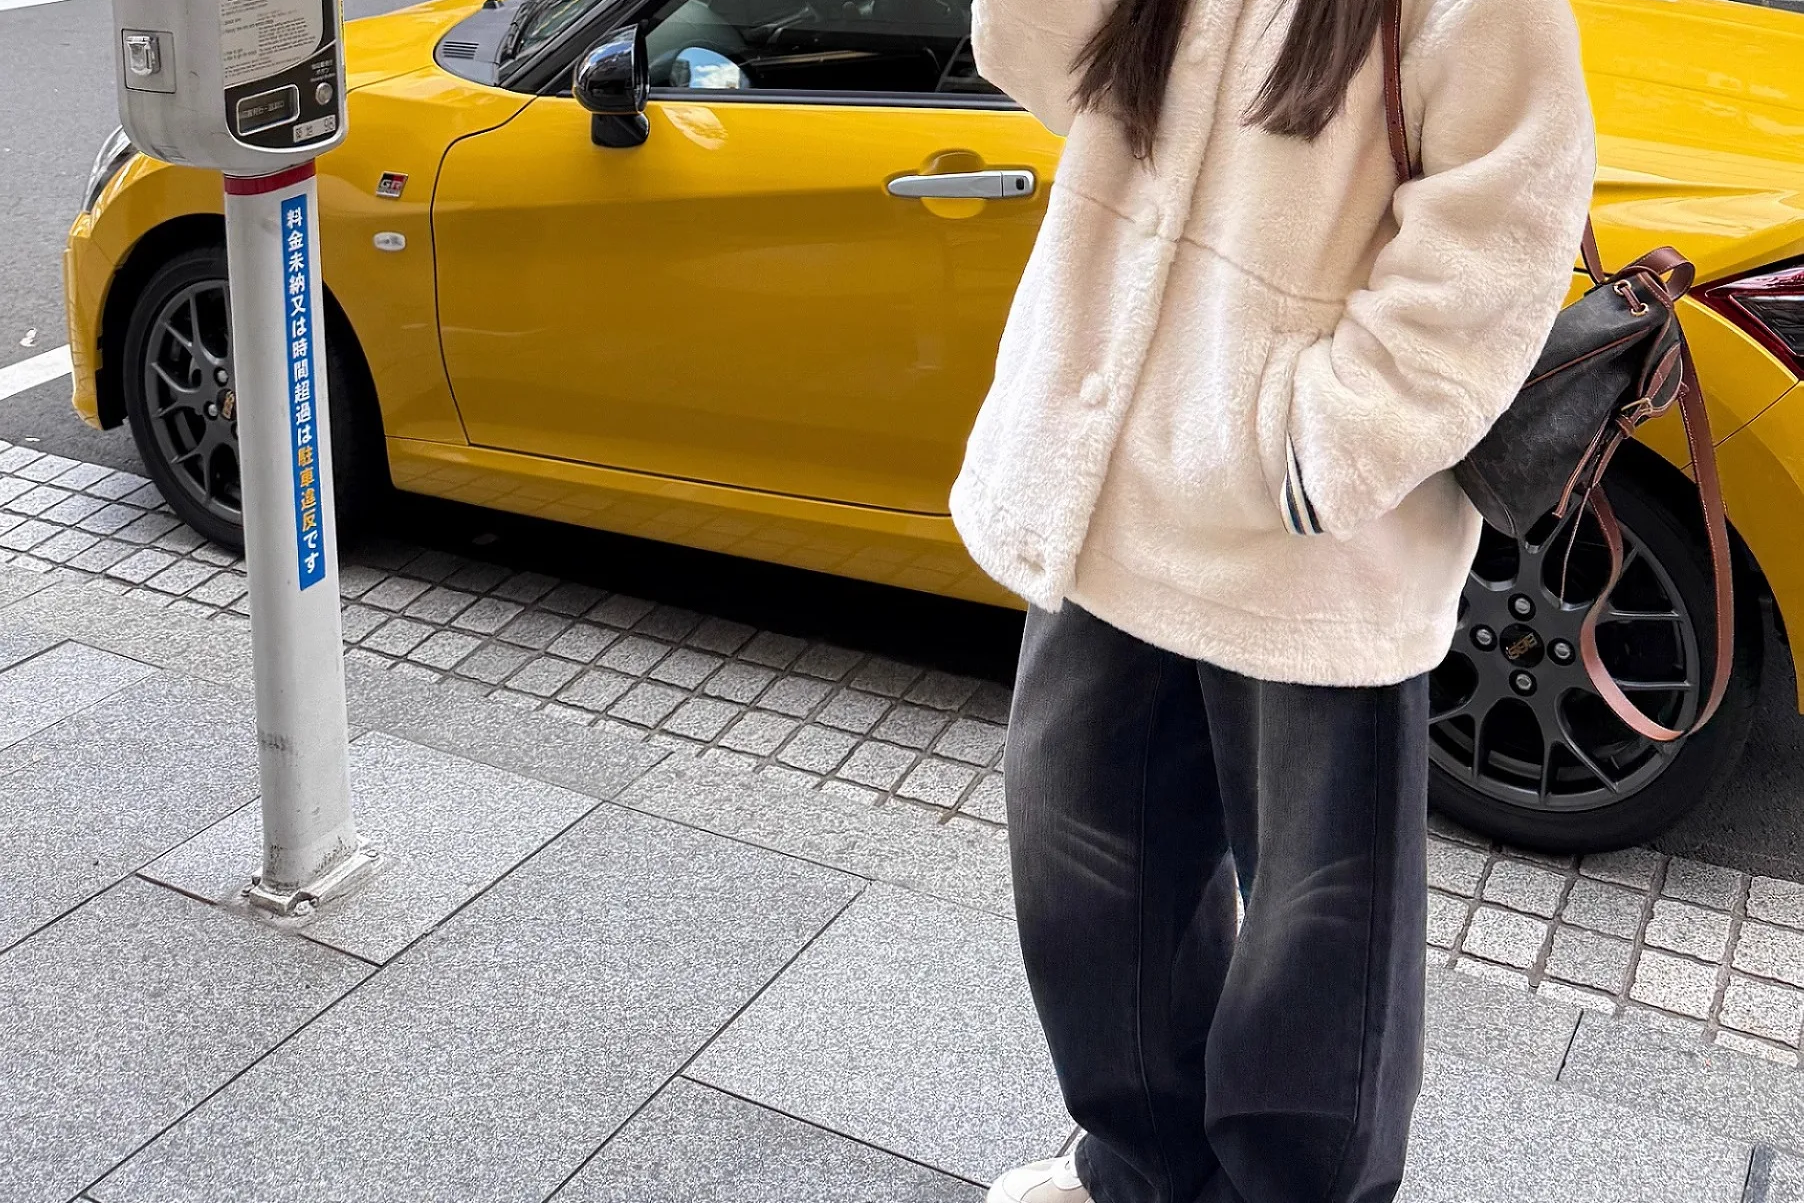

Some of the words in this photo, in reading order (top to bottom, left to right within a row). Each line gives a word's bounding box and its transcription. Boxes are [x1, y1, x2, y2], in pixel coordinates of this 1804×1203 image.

[286, 206, 320, 574] 料金未納又は時間超過は駐車違反です
